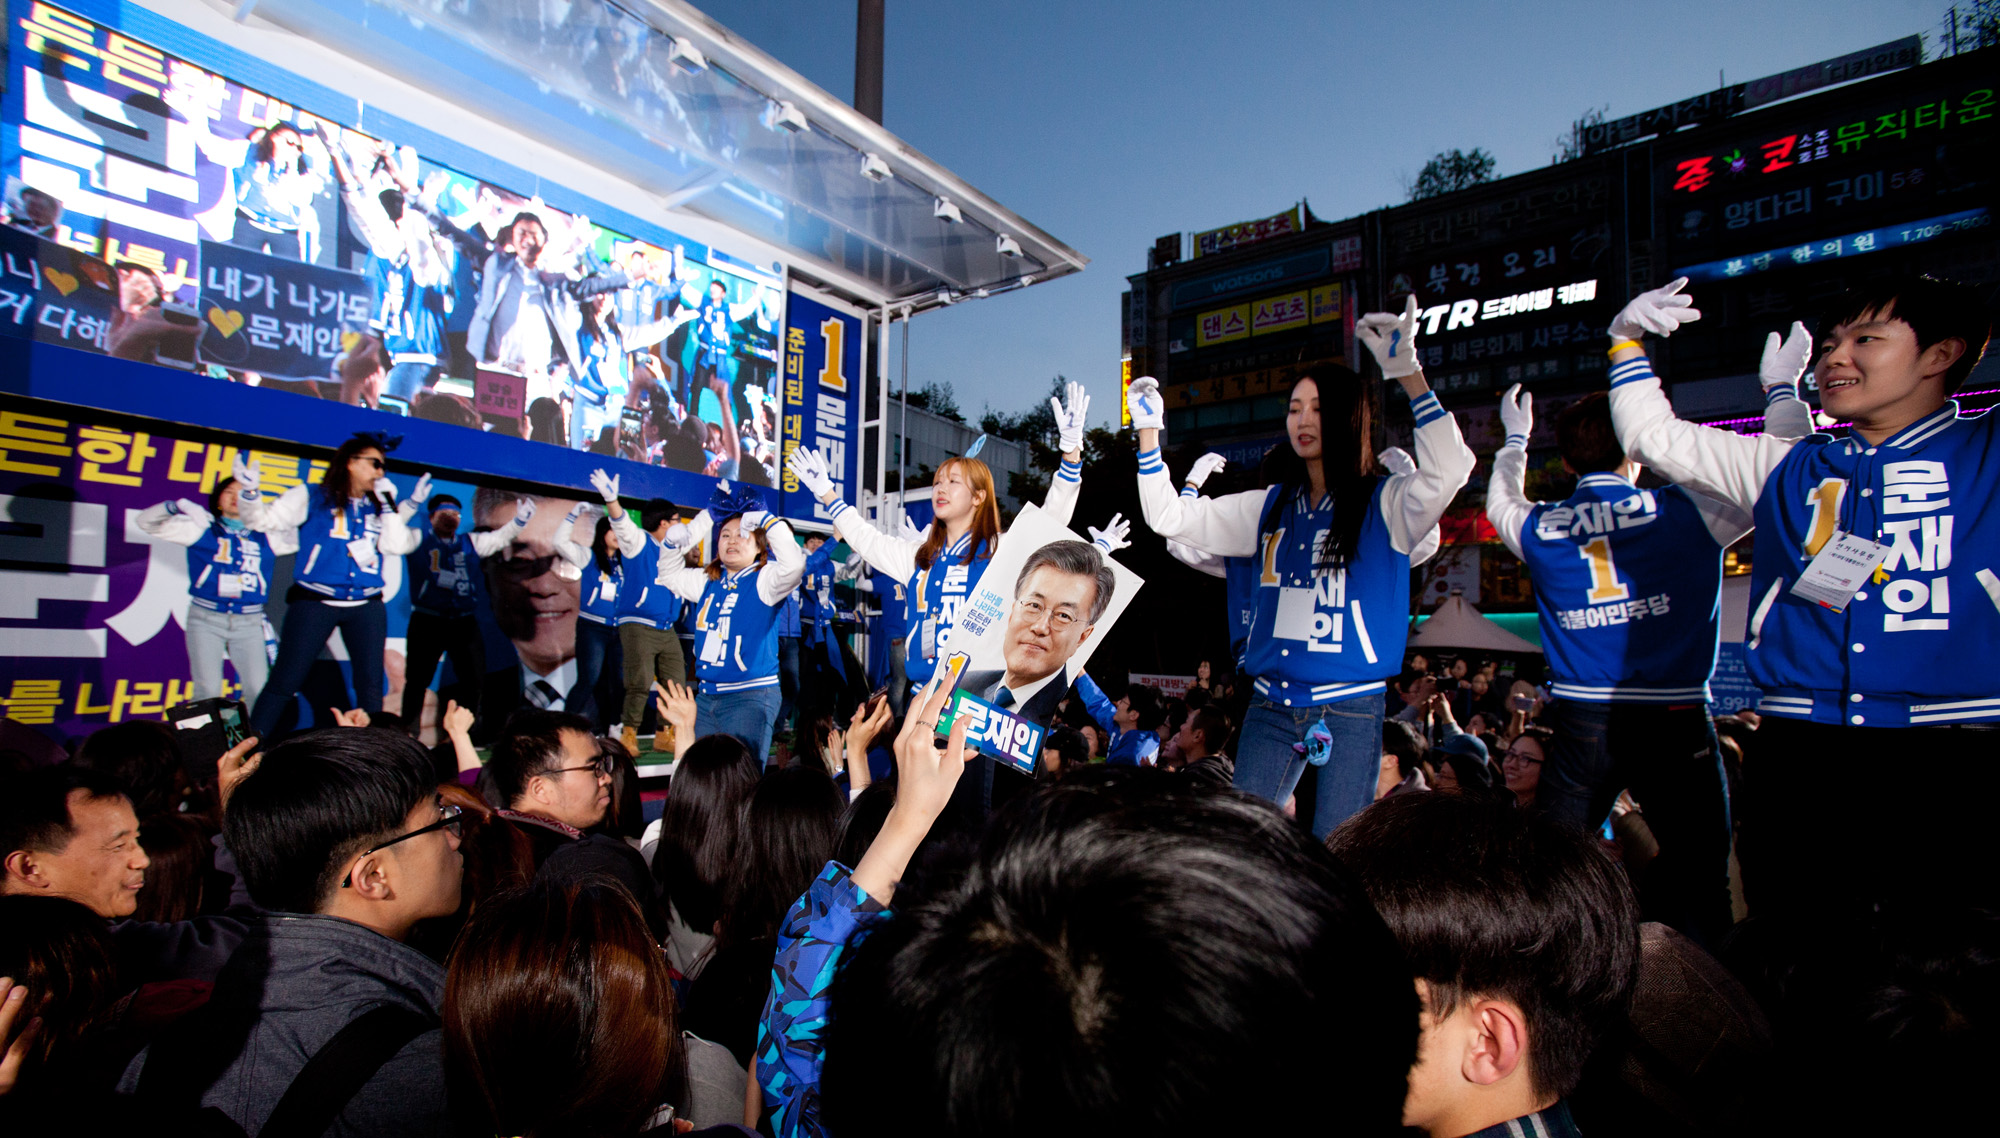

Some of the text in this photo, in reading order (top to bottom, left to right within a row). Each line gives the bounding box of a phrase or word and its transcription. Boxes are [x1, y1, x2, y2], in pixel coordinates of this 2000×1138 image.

[1834, 88, 1997, 154] 뮤직타운
[1724, 186, 1812, 230] 양다리
[1825, 171, 1884, 207] 구이
[1212, 265, 1285, 294] watsons
[1424, 245, 1558, 296] 북경 오리
[208, 266, 280, 311] 내가
[288, 279, 371, 326] 나가도
[1481, 287, 1554, 320] 드라이빙
[1556, 279, 1598, 305] 카페
[246, 313, 343, 360] 문재인
[1203, 312, 1246, 342] 댄스
[1254, 298, 1306, 329] 스포츠
[784, 326, 806, 406] 준비된
[818, 316, 847, 394] 1
[330, 507, 351, 540] 1
[1535, 491, 1658, 541] 문재인
[1801, 477, 1849, 562] 1
[213, 537, 233, 564] 1
[428, 548, 441, 573] 1
[1260, 527, 1287, 588] 1
[1882, 459, 1954, 633] 문재인
[893, 583, 904, 601] 1
[915, 567, 934, 613] 1
[1579, 534, 1630, 605] 1
[695, 593, 715, 631] 1
[967, 608, 992, 628] 든든한
[974, 599, 1005, 622] 나라답게
[980, 588, 1004, 608] 나라를
[1556, 593, 1671, 631] 더불어민주당
[961, 618, 986, 637] 대통령
[0, 679, 64, 725] 를
[951, 696, 1040, 765] 문재인
